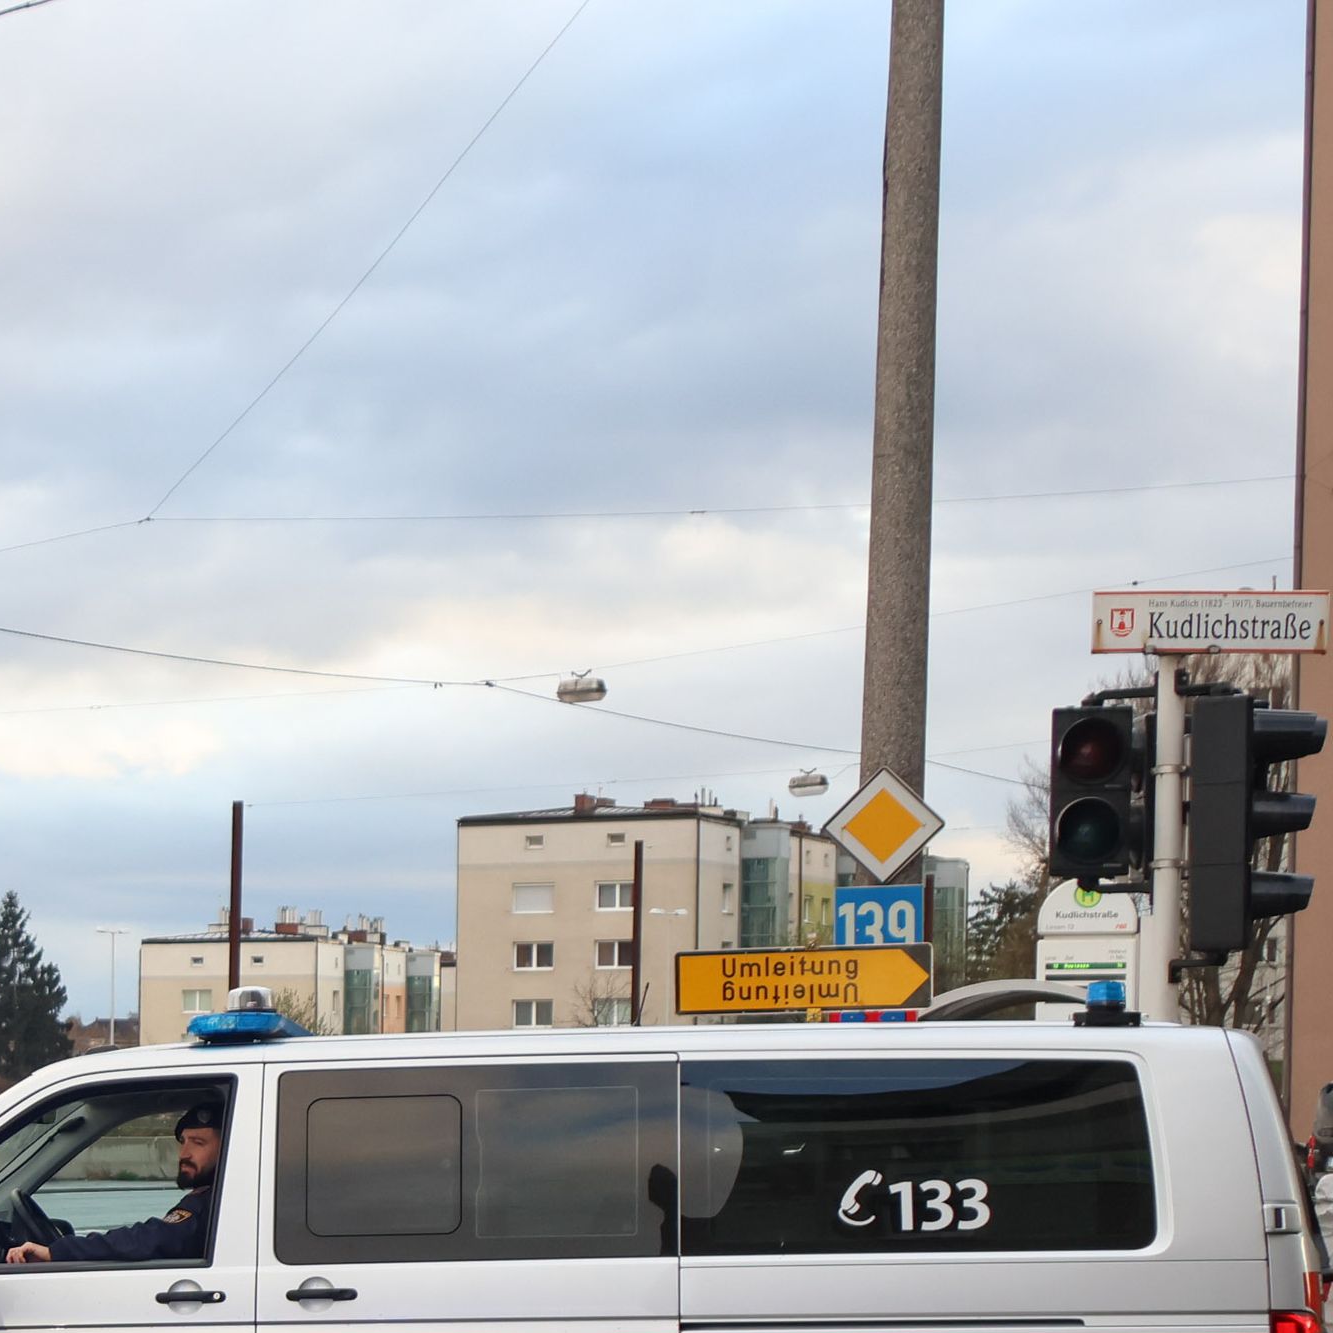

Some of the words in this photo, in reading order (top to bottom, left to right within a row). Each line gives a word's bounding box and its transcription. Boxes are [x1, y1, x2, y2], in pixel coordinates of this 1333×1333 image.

[1148, 599, 1169, 608] Hans
[1170, 599, 1199, 608] Kudlich
[1256, 599, 1314, 608] Bauernbefreier
[1148, 611, 1312, 640] Kudlichstraße
[838, 900, 916, 944] 139
[1055, 911, 1119, 919] Kudlichstraße
[721, 954, 858, 980] Umleitung
[722, 981, 858, 1004] Umleitung
[888, 1178, 991, 1231] 133
